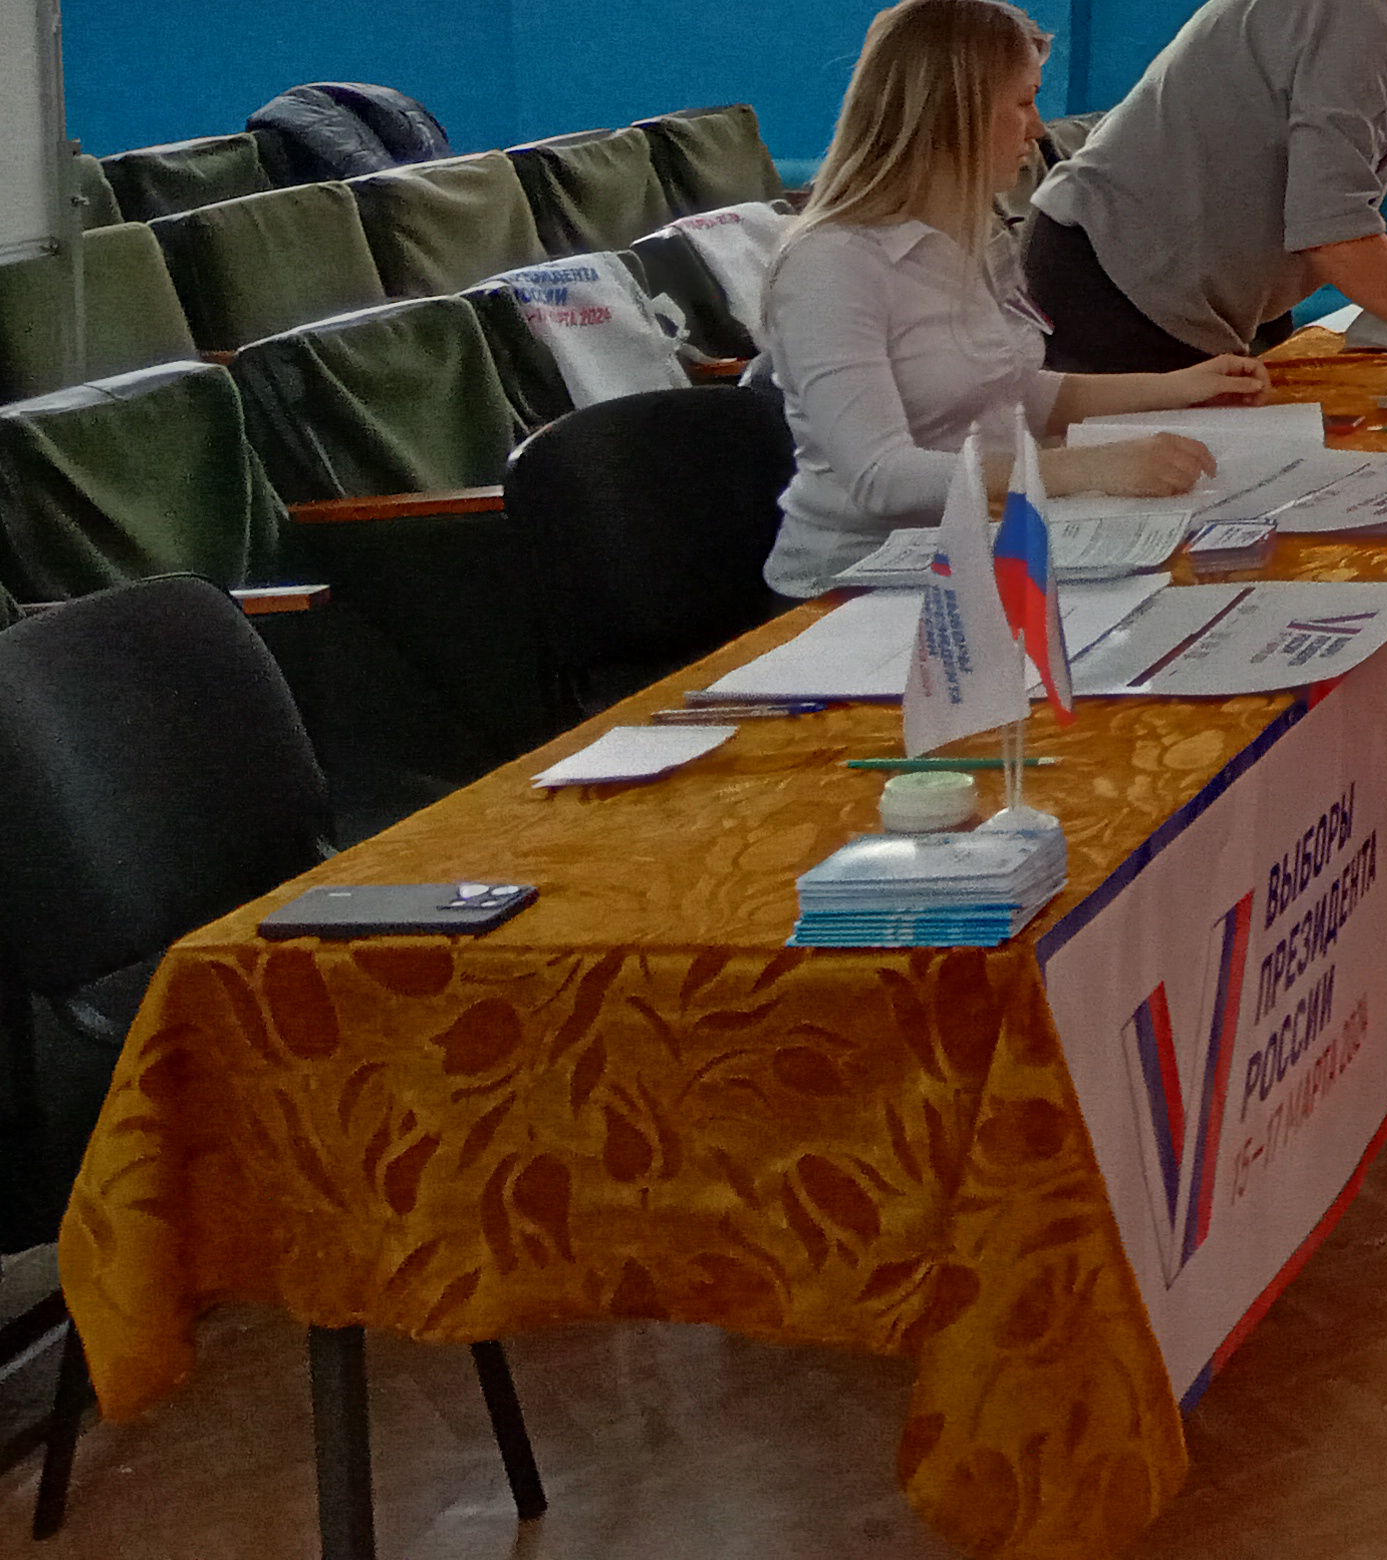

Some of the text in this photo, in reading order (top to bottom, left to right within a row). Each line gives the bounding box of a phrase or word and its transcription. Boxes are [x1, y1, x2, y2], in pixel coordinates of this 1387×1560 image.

[1254, 828, 1378, 1027] ПРЕЗИДЕНТА
[1264, 780, 1356, 931] ВЫБОРЫ
[1240, 963, 1336, 1124] РОССИИ
